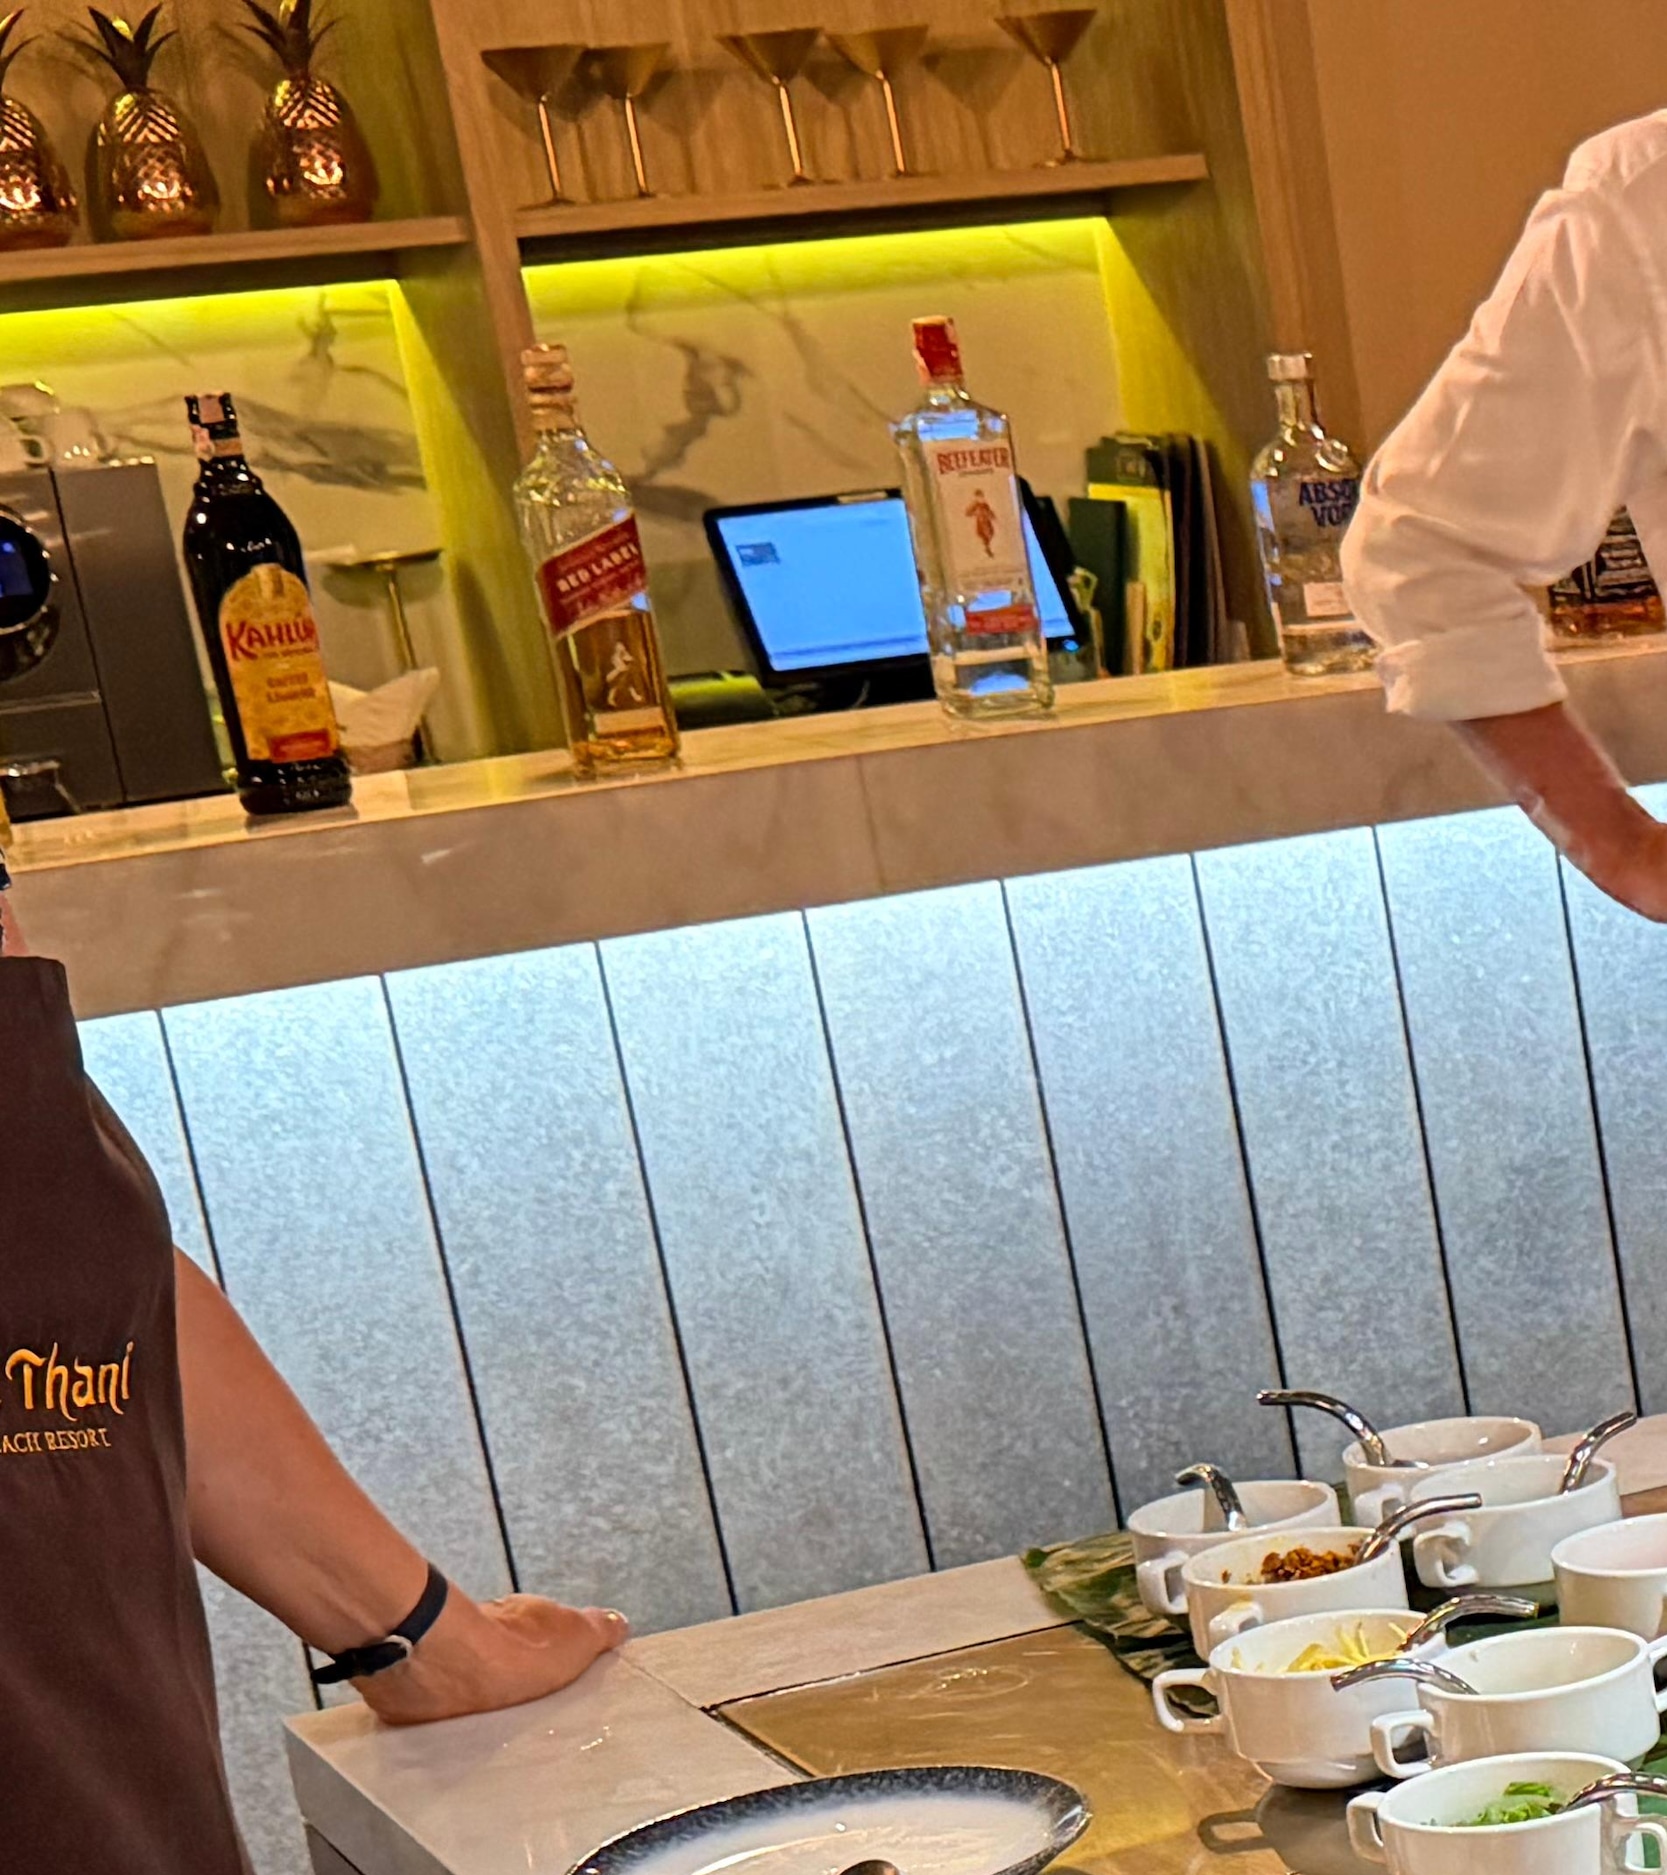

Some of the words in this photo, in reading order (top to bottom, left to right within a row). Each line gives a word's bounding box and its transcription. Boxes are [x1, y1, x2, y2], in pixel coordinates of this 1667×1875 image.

[1298, 477, 1359, 506] ABSO
[5, 1341, 134, 1421] Thani
[0, 1431, 42, 1453] ACH
[44, 1427, 112, 1450] RESORT
